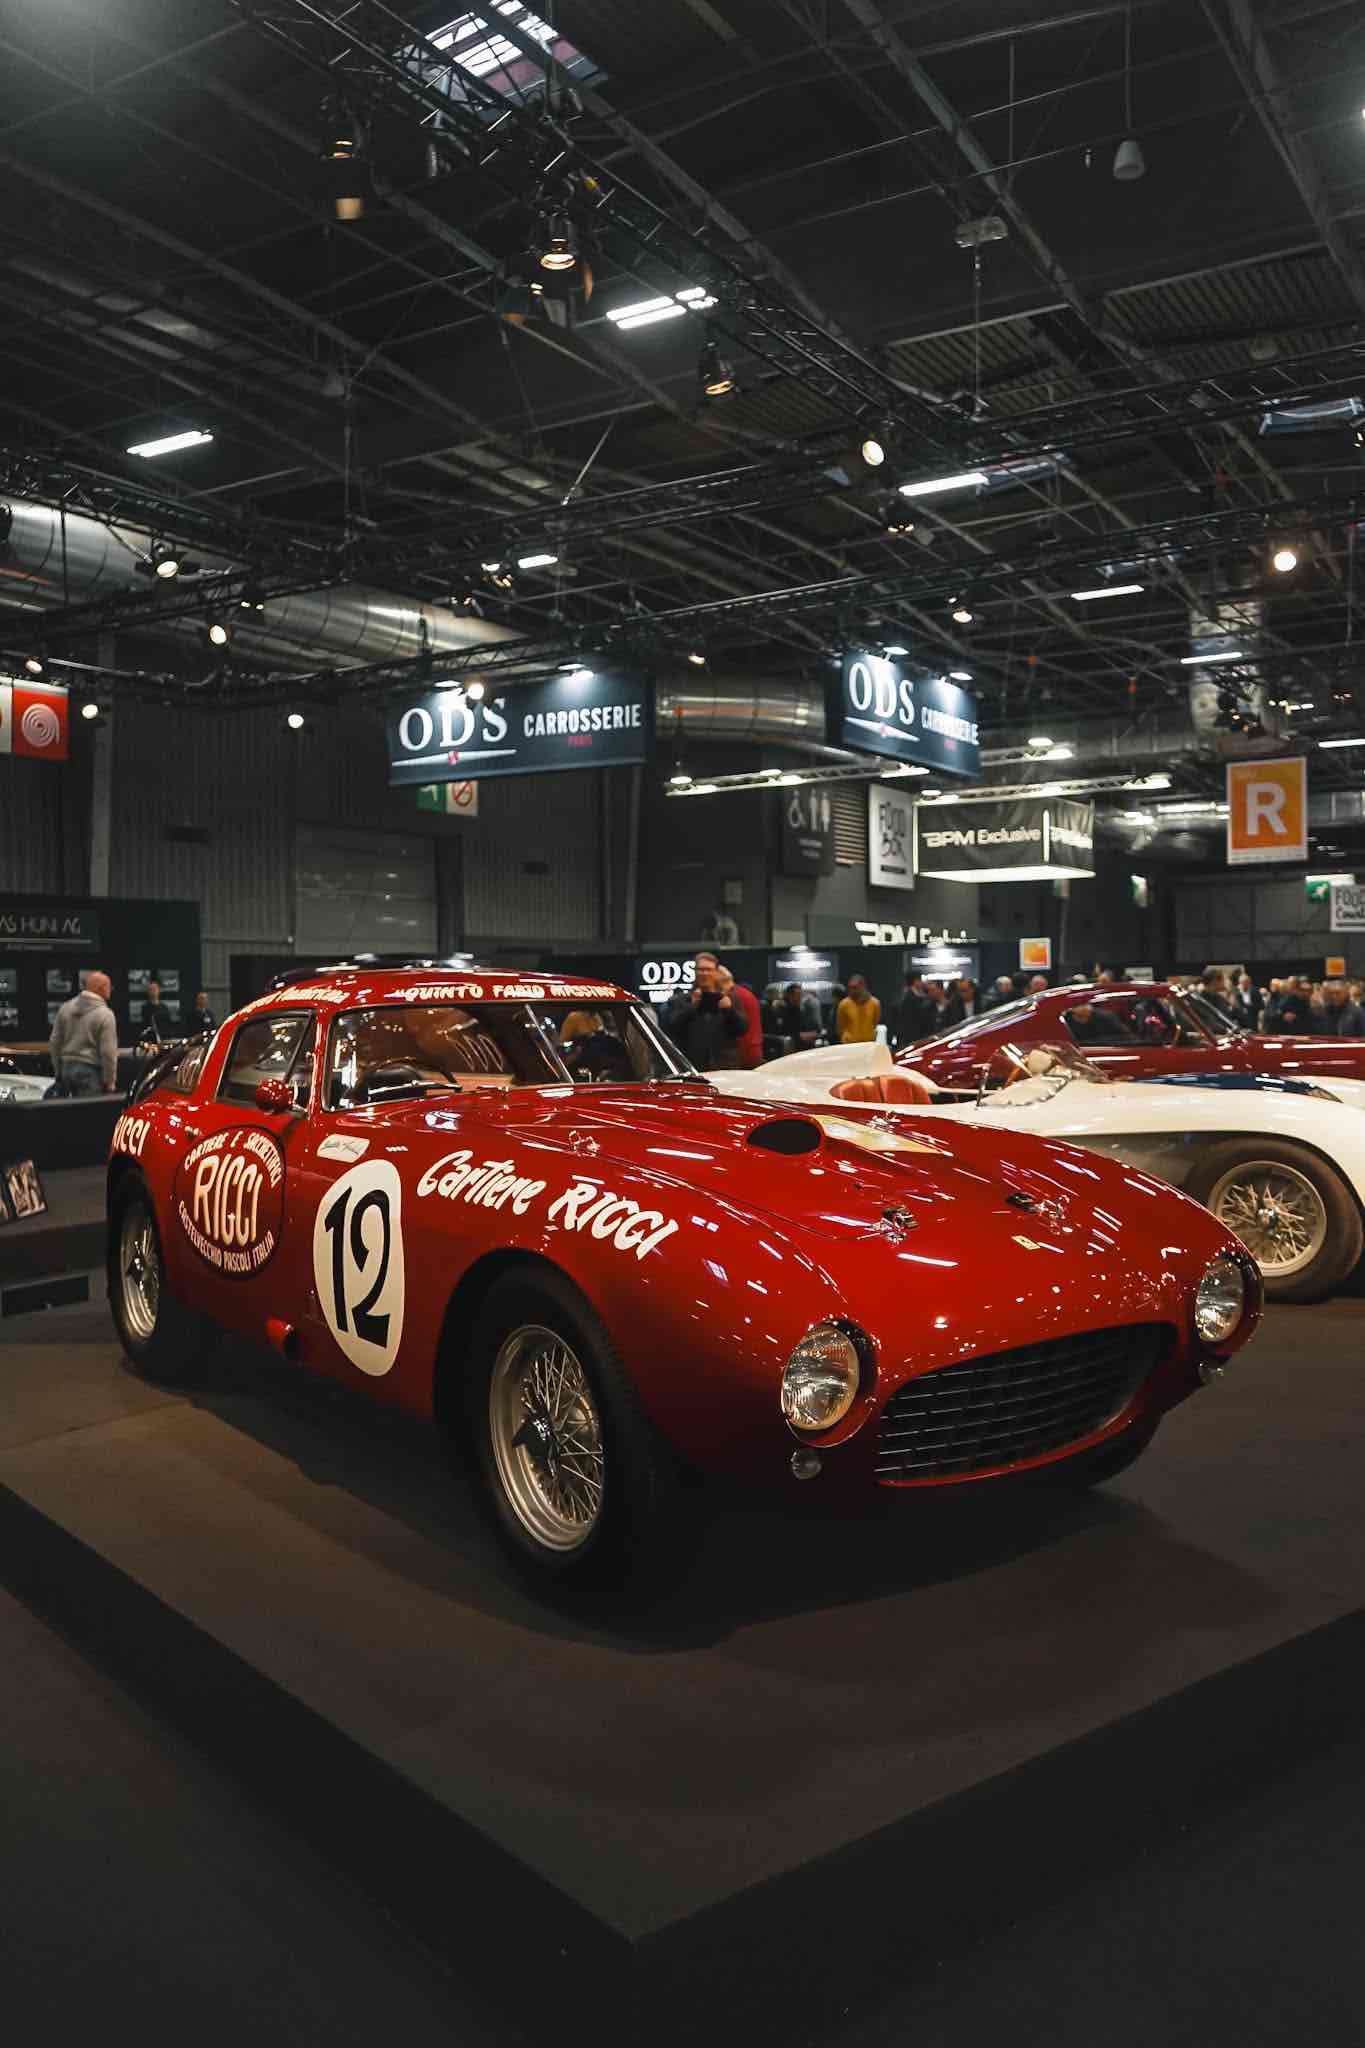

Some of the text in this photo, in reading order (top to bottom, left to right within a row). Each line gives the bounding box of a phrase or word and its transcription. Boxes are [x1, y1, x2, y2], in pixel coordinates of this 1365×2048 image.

[848, 662, 915, 725] ODS
[399, 698, 643, 751] ODS CARROSSERIE
[977, 826, 1042, 845] Exclusive
[1246, 782, 1288, 836] R
[642, 960, 697, 984] ODS
[416, 1150, 680, 1260] Cartiere RICCI
[324, 1186, 391, 1349] 12
